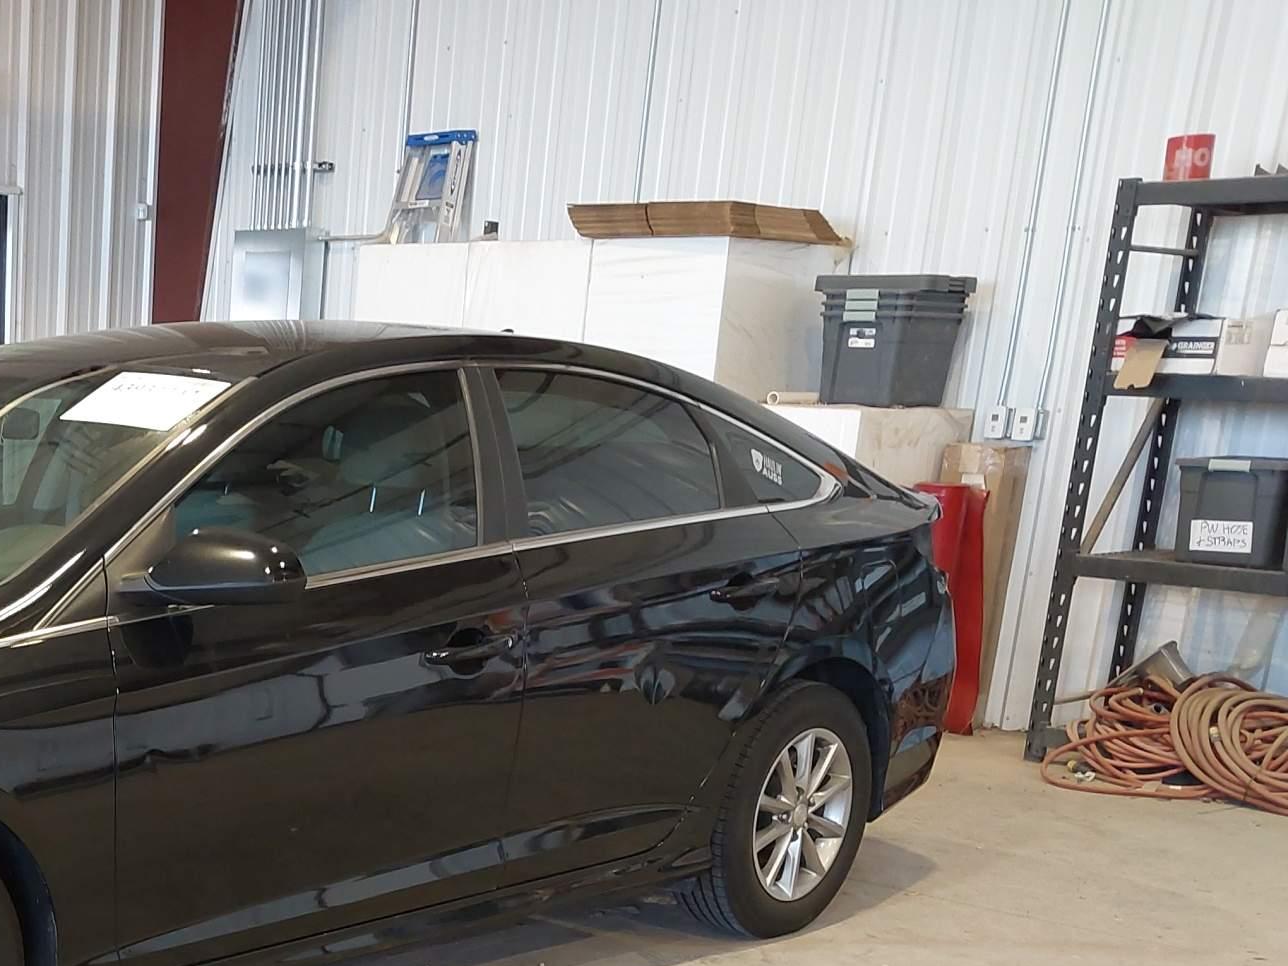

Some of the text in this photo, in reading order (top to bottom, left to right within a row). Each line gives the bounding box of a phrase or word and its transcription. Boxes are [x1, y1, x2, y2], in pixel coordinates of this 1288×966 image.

[1177, 341, 1215, 351] GRAINGER
[1200, 520, 1218, 535] PW
[1205, 536, 1247, 548] STRAPS
